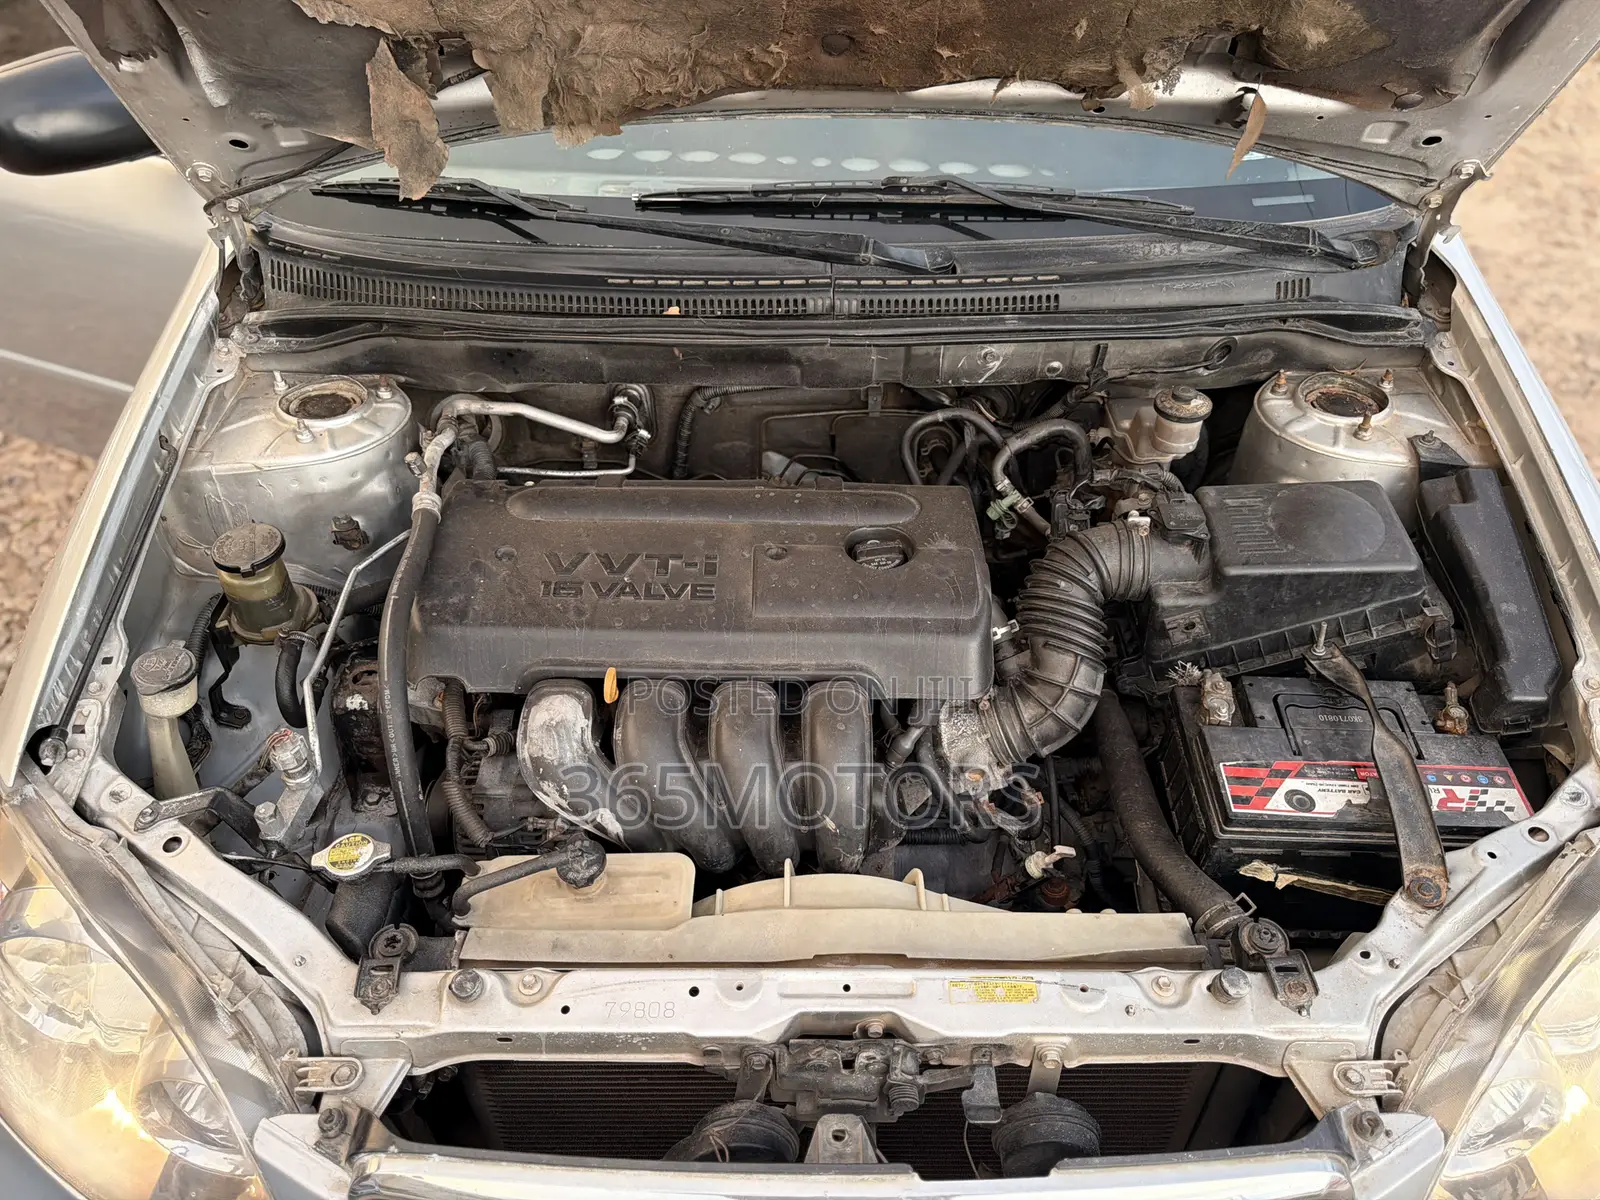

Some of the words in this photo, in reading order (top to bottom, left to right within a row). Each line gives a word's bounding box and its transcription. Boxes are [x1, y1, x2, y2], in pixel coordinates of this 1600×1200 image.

[543, 552, 719, 578] VVT-i
[539, 580, 585, 600] 16
[588, 581, 717, 601] VALVE
[604, 1001, 675, 1019] 79808
